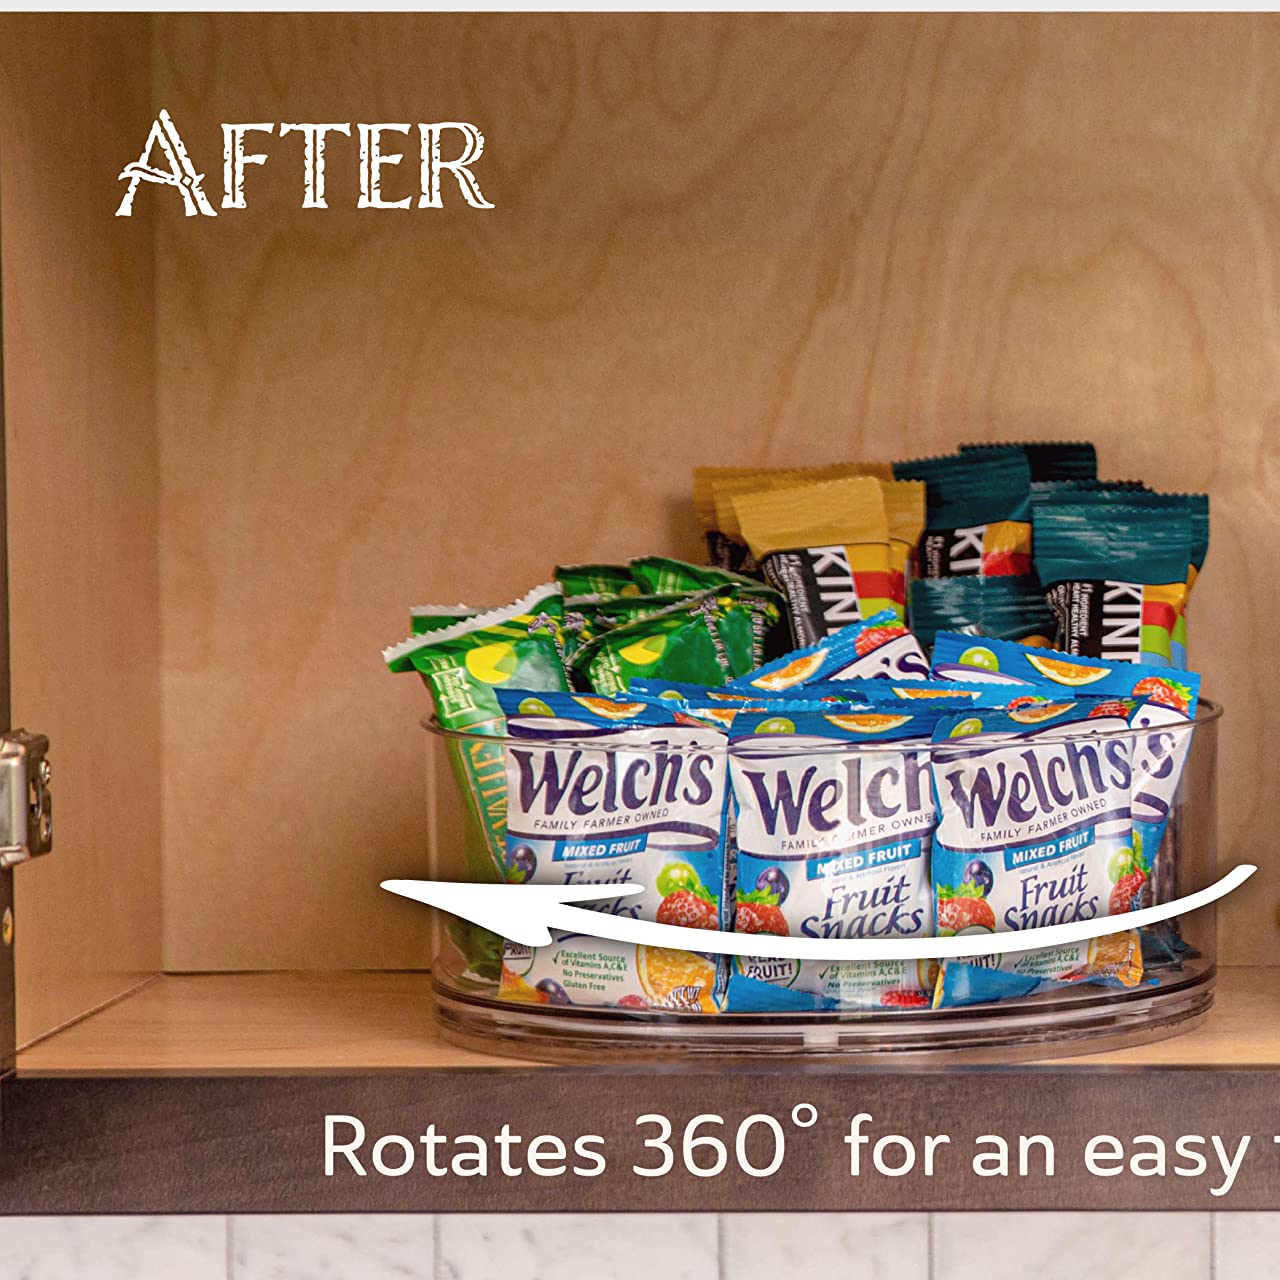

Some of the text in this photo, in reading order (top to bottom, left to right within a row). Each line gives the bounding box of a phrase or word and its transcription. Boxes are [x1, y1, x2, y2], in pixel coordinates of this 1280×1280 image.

[509, 740, 714, 816] Welch's
[741, 751, 934, 837] Welch
[946, 734, 1131, 829] Welch's
[533, 807, 669, 831] FAMILY FARMER OWNED
[980, 798, 1107, 842] FAMILY FARMER OWNED
[562, 838, 641, 859] MIXED FRUIT
[868, 843, 912, 862] FRUIT
[1012, 831, 1090, 865] MIXED FRUIT
[823, 875, 911, 921] Fruit
[1020, 864, 1089, 912] Fruit
[800, 904, 924, 938] Snacks
[1003, 892, 1099, 932] Snacks
[561, 950, 626, 963] Excellent Source
[571, 958, 600, 969] Vitamins
[563, 970, 625, 983] No Preservatives
[563, 979, 606, 991] Gluten Free
